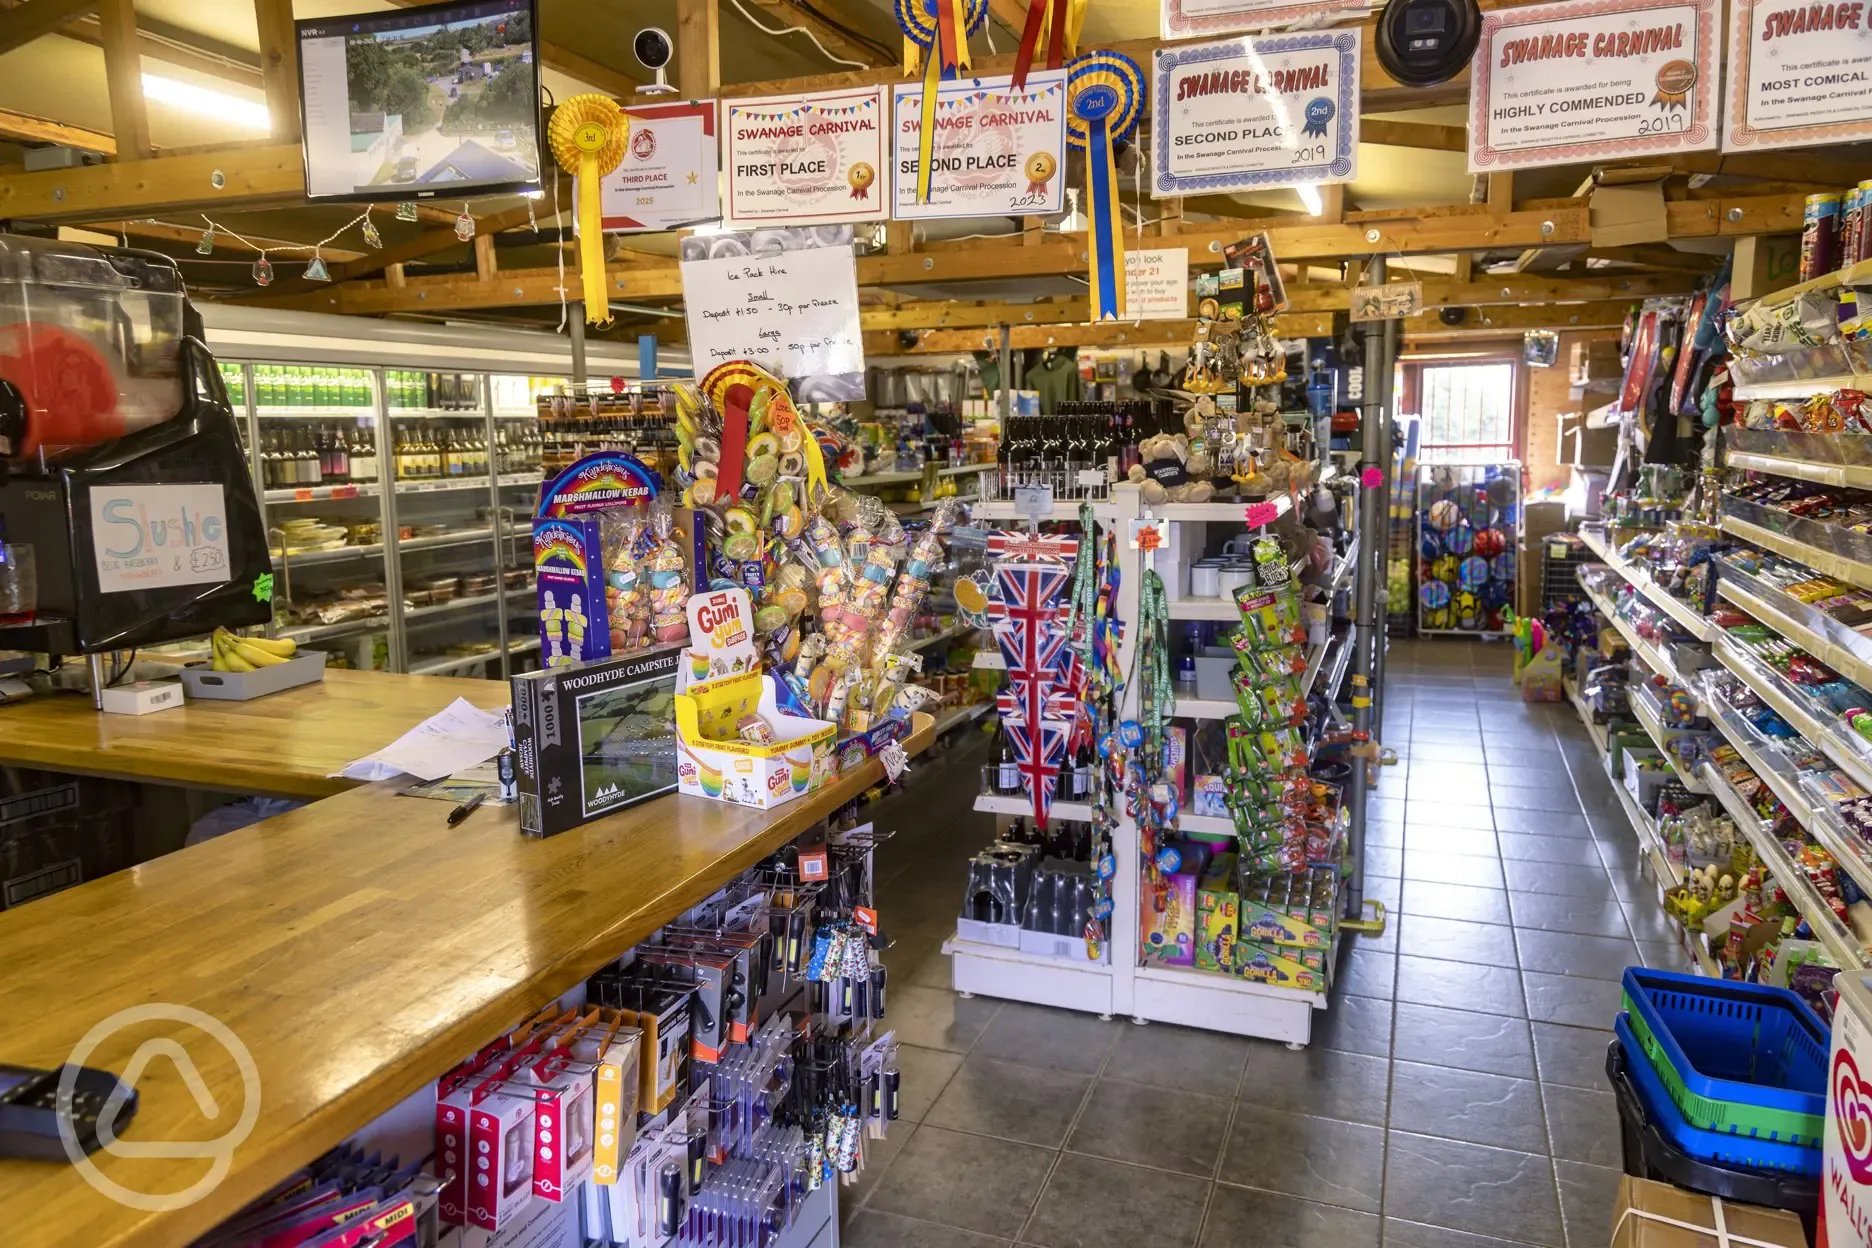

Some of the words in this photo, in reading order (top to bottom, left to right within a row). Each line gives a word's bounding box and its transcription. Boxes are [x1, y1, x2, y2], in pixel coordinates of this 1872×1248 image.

[1762, 2, 1864, 41] SWANAGE
[1500, 32, 1589, 68] SWANAGE
[1593, 23, 1682, 58] CARNIVAL
[1800, 60, 1840, 70] certificate
[1177, 70, 1250, 102] SWANAGE
[1503, 92, 1518, 100] This
[1520, 87, 1554, 98] certificate
[1564, 83, 1597, 92] awarded
[1598, 82, 1608, 90] for
[1610, 78, 1632, 90] being
[1761, 79, 1800, 92] MOST
[1804, 72, 1868, 87] COMICAL
[1086, 96, 1105, 110] 2nd
[1772, 97, 1784, 105] the
[1787, 94, 1827, 104] Swanage
[1829, 88, 1866, 99] Carnival
[1310, 105, 1328, 116] 2nd
[1494, 104, 1546, 120] HIGHLY
[1550, 92, 1646, 114] COMMENDED
[737, 126, 804, 140] SWANAGE
[808, 118, 876, 136] CARNIVAL
[902, 116, 974, 133] SWNAGE
[979, 109, 1054, 128] CARNIVAL
[1205, 118, 1236, 127] certificate
[1243, 115, 1270, 124] awarded
[1508, 126, 1522, 134] the
[1524, 122, 1559, 133] Swanage
[1560, 118, 1594, 128] Carnival
[1595, 113, 1641, 125] Procession
[1638, 114, 1683, 134] 2019
[584, 132, 596, 142] 3rd
[1174, 130, 1238, 146] SECOND
[1242, 124, 1285, 140] PLAC
[1196, 151, 1225, 159] Swanage
[1226, 147, 1254, 156] Carnival
[1255, 145, 1288, 153] Process
[1292, 146, 1325, 164] 2019
[737, 164, 776, 177] FIRST
[780, 160, 826, 175] PLACE
[900, 157, 962, 174] SEOND
[966, 154, 1017, 170] PLACE
[622, 175, 643, 184] THIRD
[645, 173, 668, 182] PLACE
[756, 187, 785, 197] Swanage
[786, 186, 812, 195] Carnival
[813, 184, 846, 193] Procession
[950, 183, 978, 192] Carnival
[1009, 194, 1046, 208] 2023
[1144, 254, 1163, 263] look
[728, 271, 740, 281] Ice
[743, 268, 763, 278] Pack
[769, 266, 787, 275] Hire
[1149, 267, 1160, 276] 21
[748, 290, 770, 301] Small
[702, 308, 730, 322] Deposit
[778, 303, 793, 316] 30p
[798, 304, 810, 314] per
[758, 328, 782, 342] Large
[710, 348, 736, 361] Deposit
[788, 343, 805, 352] 50p
[810, 342, 821, 351] per
[578, 460, 630, 481] Kandelicious
[553, 488, 621, 504] MARSHMALLOW
[622, 486, 649, 497] KEBAB
[102, 498, 222, 559] Slushie
[534, 524, 582, 556] Kandelicious
[536, 564, 570, 575] MARSHMALLOW
[570, 567, 586, 577] KEBAB
[697, 596, 740, 634] Gumi
[710, 618, 742, 649] yum
[727, 632, 747, 646] SURPRISE
[562, 668, 625, 691] WOODHYDE
[626, 658, 674, 676] CAMPSITE
[544, 705, 556, 740] 1000
[695, 740, 715, 749] STRETCHY
[771, 744, 789, 754] YUMMY
[789, 740, 806, 751] GUMMY
[1168, 735, 1180, 769] SQUISHY
[678, 765, 697, 776] Gumi
[768, 769, 790, 790] Gumi
[588, 789, 626, 808] WOODYHYDE
[1250, 926, 1285, 940] GORILLA
[1244, 967, 1277, 980] GORILLA
[385, 1208, 408, 1225] MIDI
[504, 1234, 518, 1248] Terms
